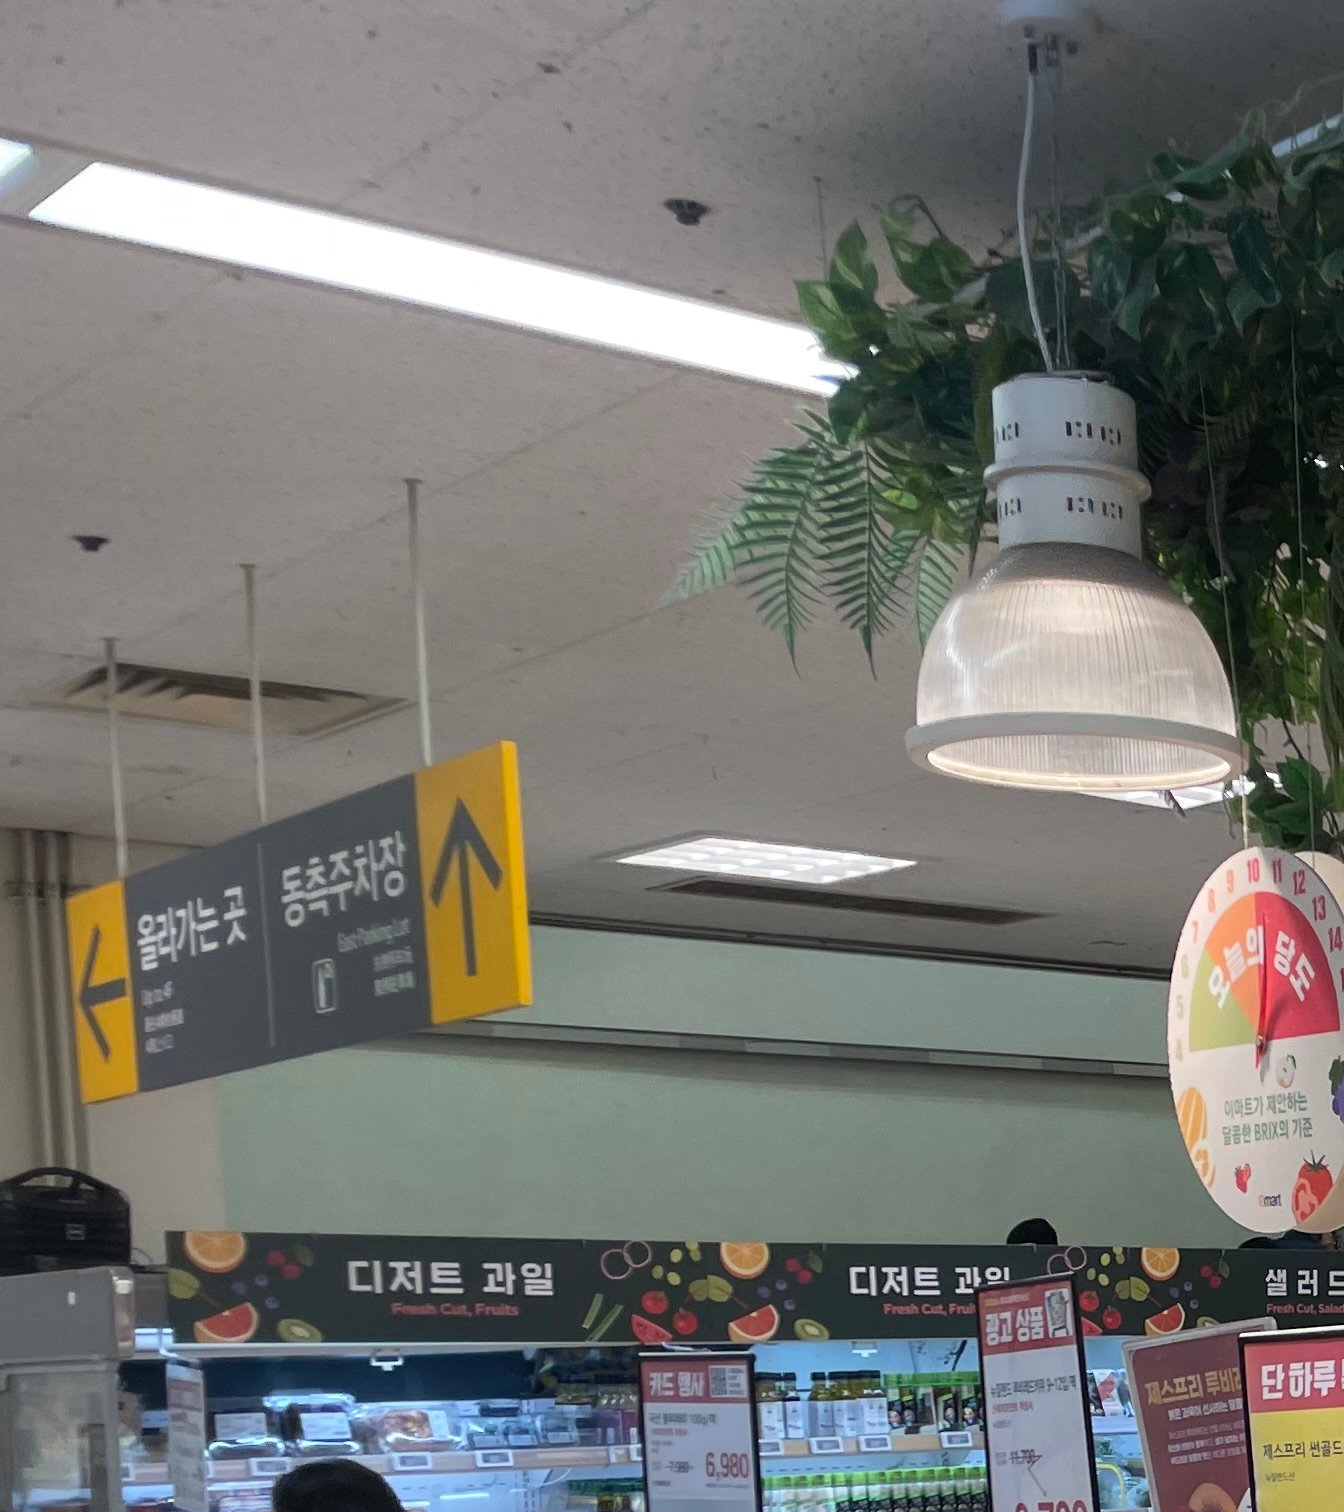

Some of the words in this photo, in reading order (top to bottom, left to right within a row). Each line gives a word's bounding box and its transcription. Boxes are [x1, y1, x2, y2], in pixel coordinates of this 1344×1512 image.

[280, 830, 407, 928] 동측주차장
[1226, 870, 1234, 892] 9
[1247, 859, 1259, 883] 10
[1273, 859, 1283, 883] 11
[1293, 870, 1306, 895] 12
[1208, 889, 1216, 912] 8
[1312, 896, 1326, 921] 13
[137, 897, 219, 972] 올라가는
[223, 885, 247, 946] 곳
[1191, 921, 1199, 943] 7
[1328, 926, 1343, 952] 14
[1208, 925, 1264, 1009] 오늘의
[1273, 930, 1316, 1002] 당도
[1224, 1096, 1264, 1119] 이마트가
[1266, 1093, 1308, 1115] 제안하는
[1254, 1119, 1289, 1142] BRIX의
[1291, 1117, 1313, 1139] 기준
[347, 1260, 465, 1294] 디저트
[482, 1262, 554, 1296] 과일
[849, 1266, 942, 1296] 디저트
[954, 1266, 1010, 1295] 과일
[391, 1303, 437, 1315] Fresh
[440, 1304, 473, 1317] Cut,
[475, 1303, 519, 1316] Fruits
[883, 1304, 920, 1315] Fresh
[921, 1304, 948, 1316] Cut,
[1266, 1303, 1293, 1315] Fresh
[1295, 1304, 1315, 1317] Cut,
[1016, 1307, 1044, 1343] 상품
[650, 1372, 674, 1396] 카드
[1144, 1373, 1203, 1405] 제스프리
[1261, 1364, 1285, 1401] 단
[1288, 1360, 1335, 1398] 하루
[1262, 1439, 1306, 1458] 제스프리
[705, 1452, 749, 1481] 6,980
